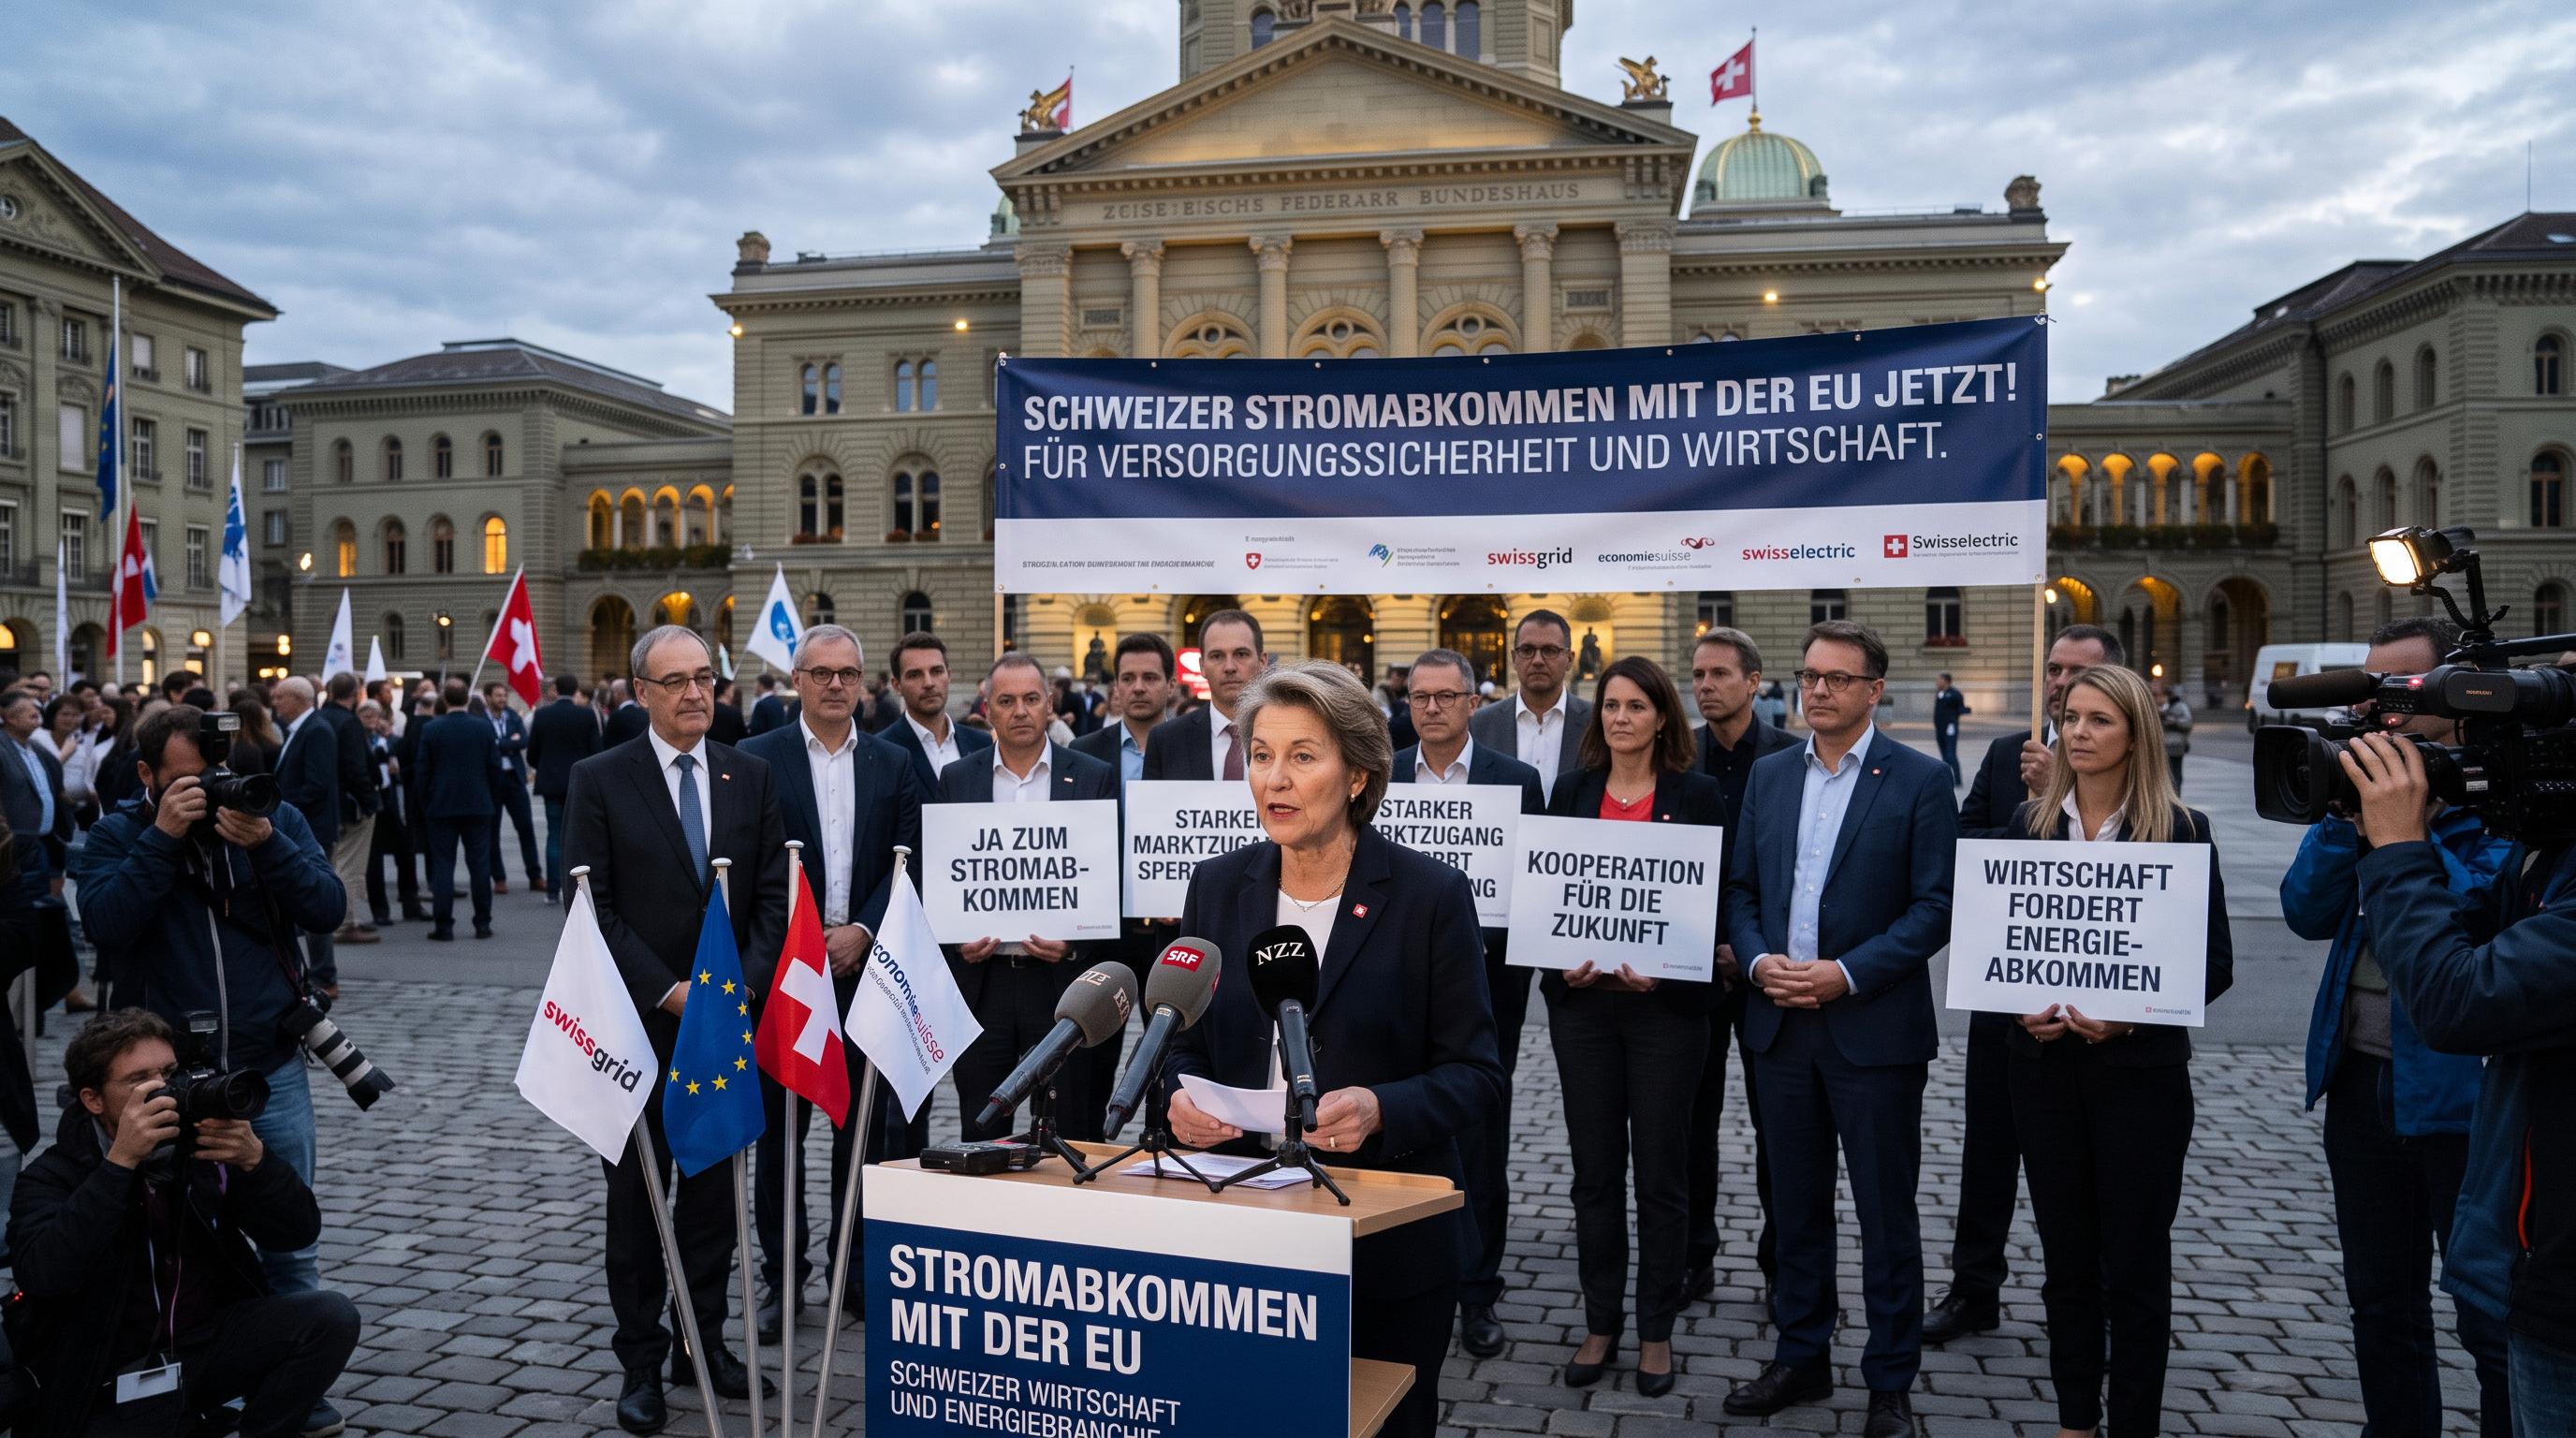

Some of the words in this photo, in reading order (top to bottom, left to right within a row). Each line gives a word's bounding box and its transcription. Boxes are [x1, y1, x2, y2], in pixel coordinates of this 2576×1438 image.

[1420, 183, 1579, 205] BUNDESHAUS
[1024, 395, 1234, 432] SCHWEIZER
[1244, 386, 1615, 431] STROMABKOMMEN
[1628, 381, 1704, 421] MIT
[1716, 376, 1795, 417] DER
[1808, 373, 1861, 412] EU
[1874, 361, 2016, 408] JETZT!
[1024, 435, 1088, 479] FÜR
[1097, 436, 1578, 478] VERSORGUNGSSICHERHEIT
[1589, 433, 1670, 472] UND
[1681, 421, 1947, 468] WIRTSCHAFT.
[1487, 546, 1573, 570] swissgrid
[1597, 549, 1692, 564] economiesuisse
[1742, 542, 1855, 561] swisselectric
[1911, 532, 2019, 550] Swisselectric
[1379, 799, 1472, 820] STARKER
[971, 828, 1004, 852] JA
[1012, 826, 1068, 851] ZUM
[1373, 825, 1503, 846] RKTZUGANG
[950, 856, 1090, 883] STROMAB-
[1528, 850, 1705, 886] KOOPERATION
[1983, 858, 2174, 891] WIRTSCHAFT
[963, 886, 1078, 913] KOMMEN
[1562, 878, 1612, 910] FÜR
[1619, 887, 1662, 914] DIE
[2009, 892, 2144, 923] FORDERT
[1551, 913, 1670, 946] ZUKUNFT
[2006, 925, 2143, 957] ENERGIE-
[1166, 949, 1200, 965] SRF
[1255, 942, 1305, 966] NZZ
[1984, 956, 2161, 992] ABKOMMEN
[544, 1001, 643, 1093] swissgrid
[889, 1243, 1318, 1343] STROMABKOMMEN
[891, 1298, 969, 1350] MIT
[984, 1311, 1070, 1366] DER
[1086, 1324, 1141, 1375] EU
[890, 1359, 1021, 1403] SCHWEIZER
[1027, 1379, 1182, 1427] WIRTSCHAFT
[891, 1389, 937, 1419] UND
